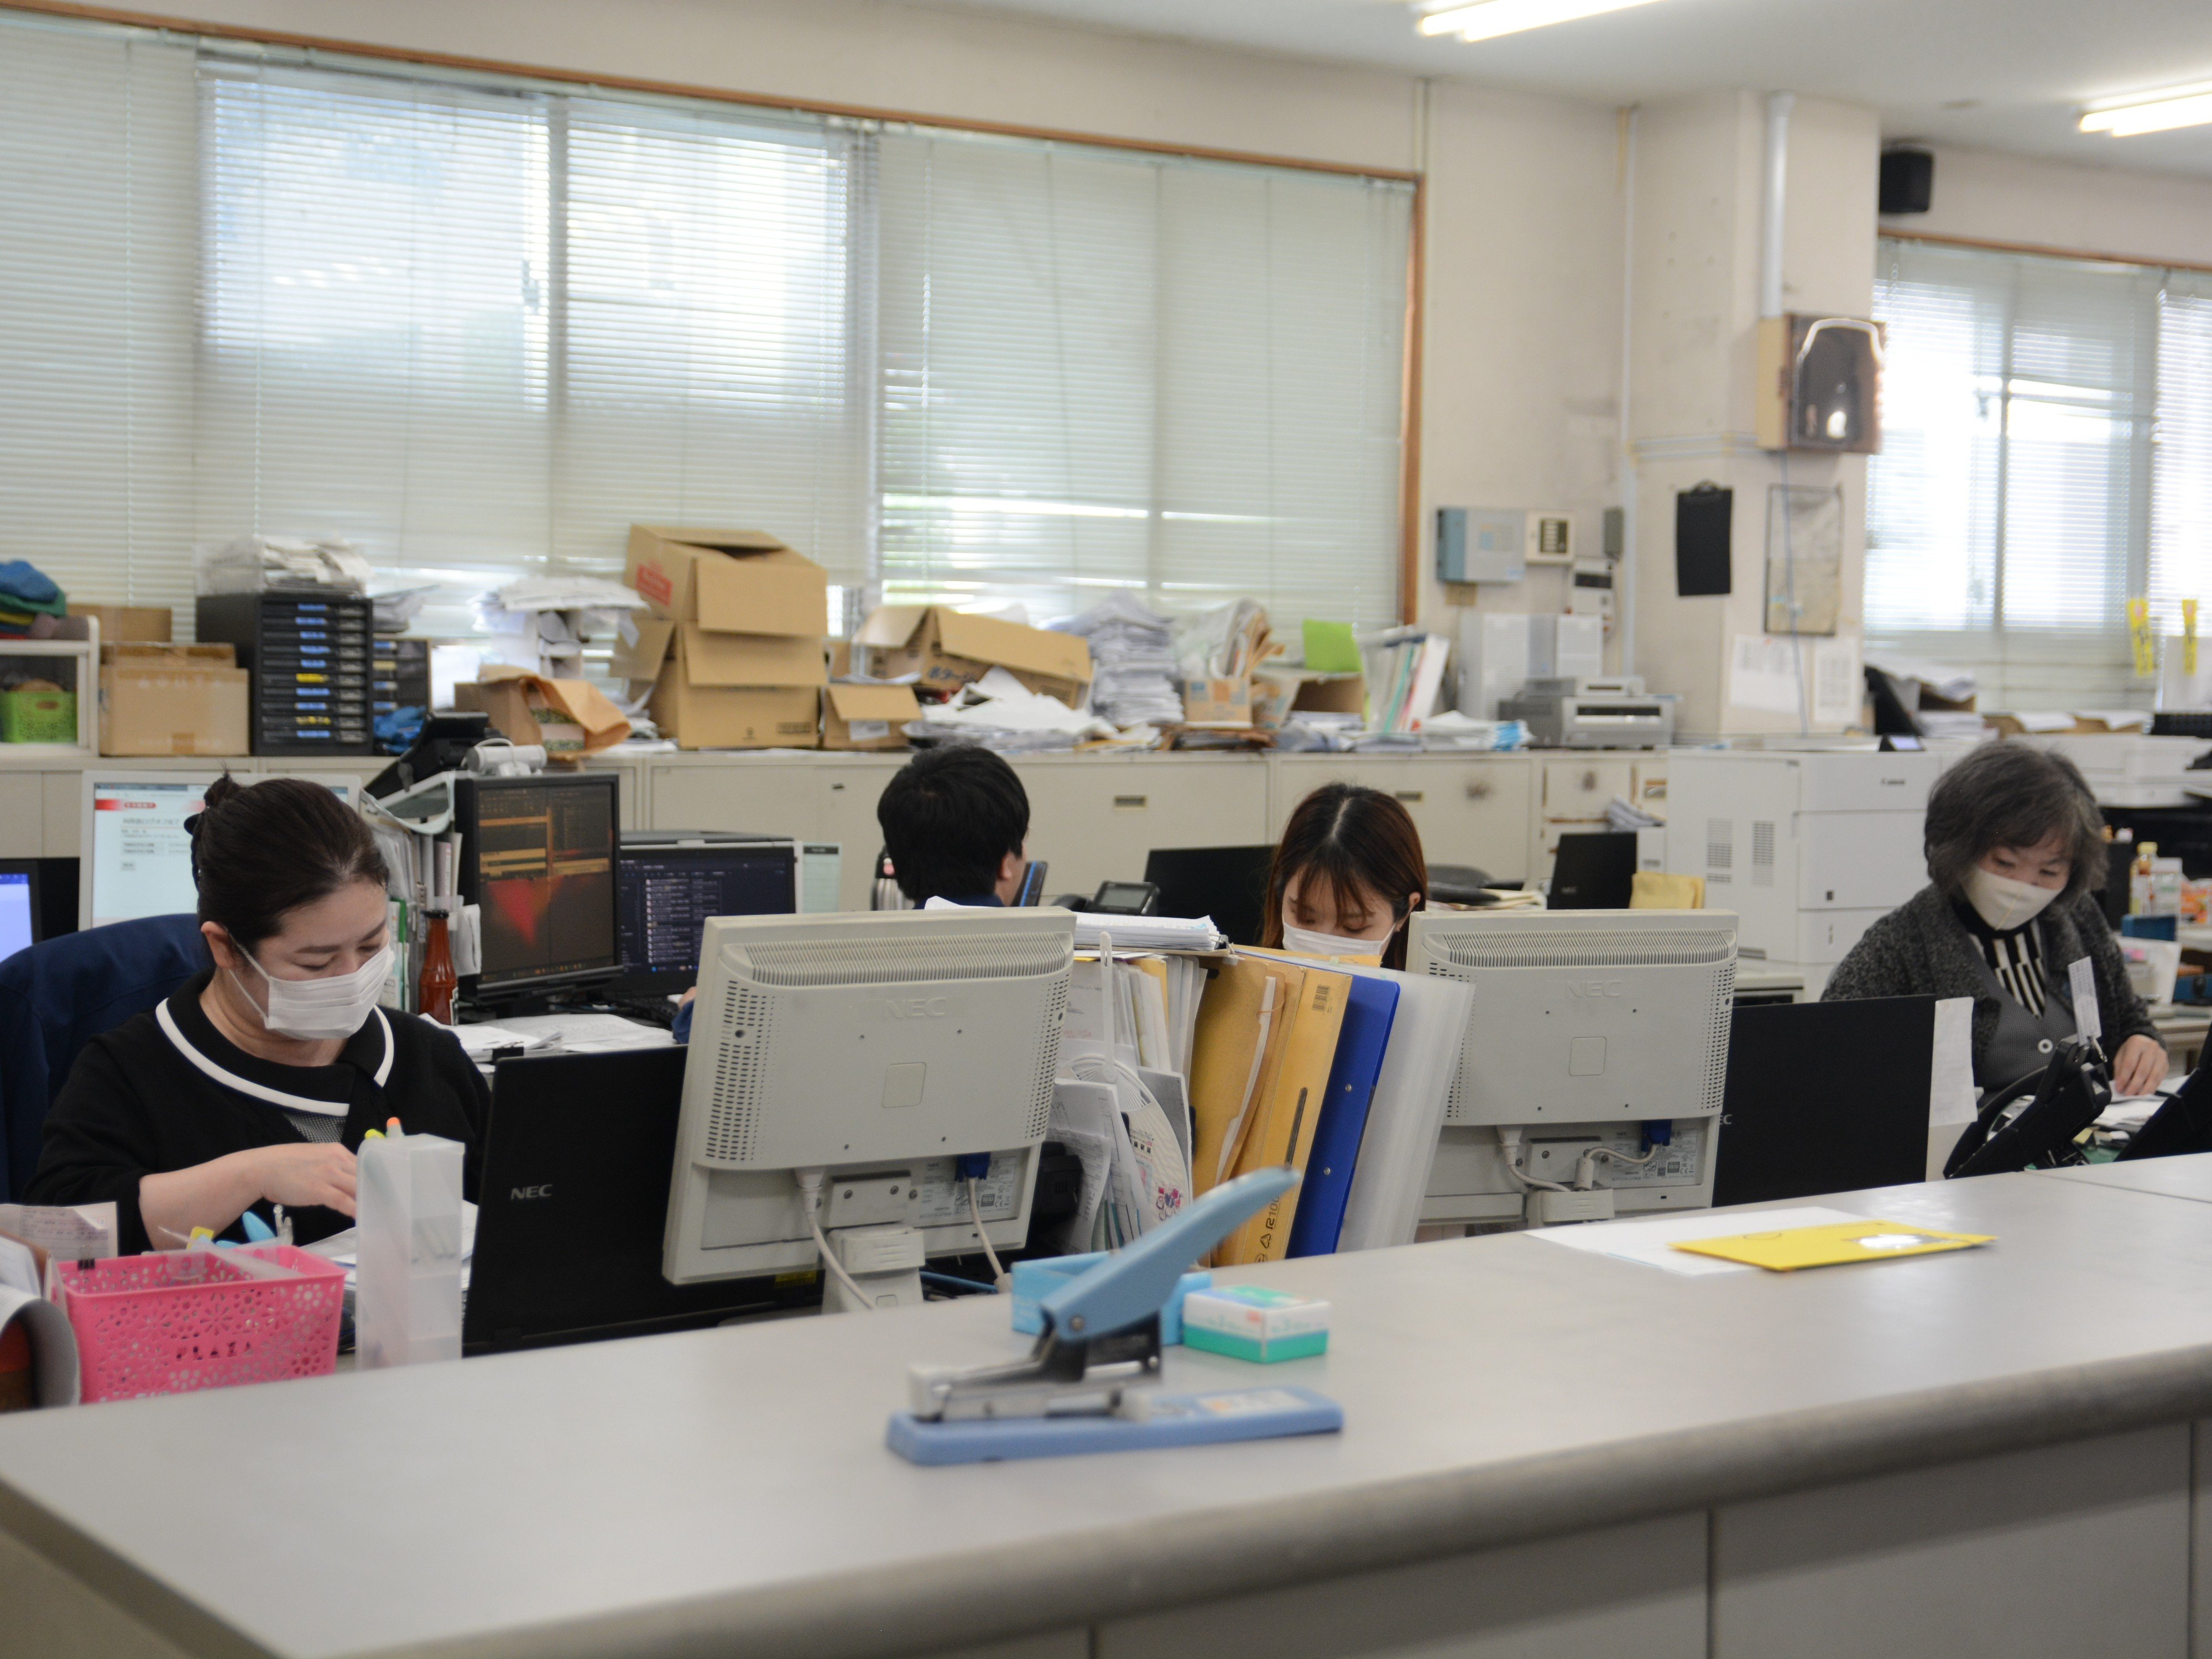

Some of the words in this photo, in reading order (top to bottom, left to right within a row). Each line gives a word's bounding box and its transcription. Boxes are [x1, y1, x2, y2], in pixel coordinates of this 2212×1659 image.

[1564, 979, 1621, 998] NEC
[885, 997, 947, 1019] NEC
[510, 1184, 553, 1199] NEC
